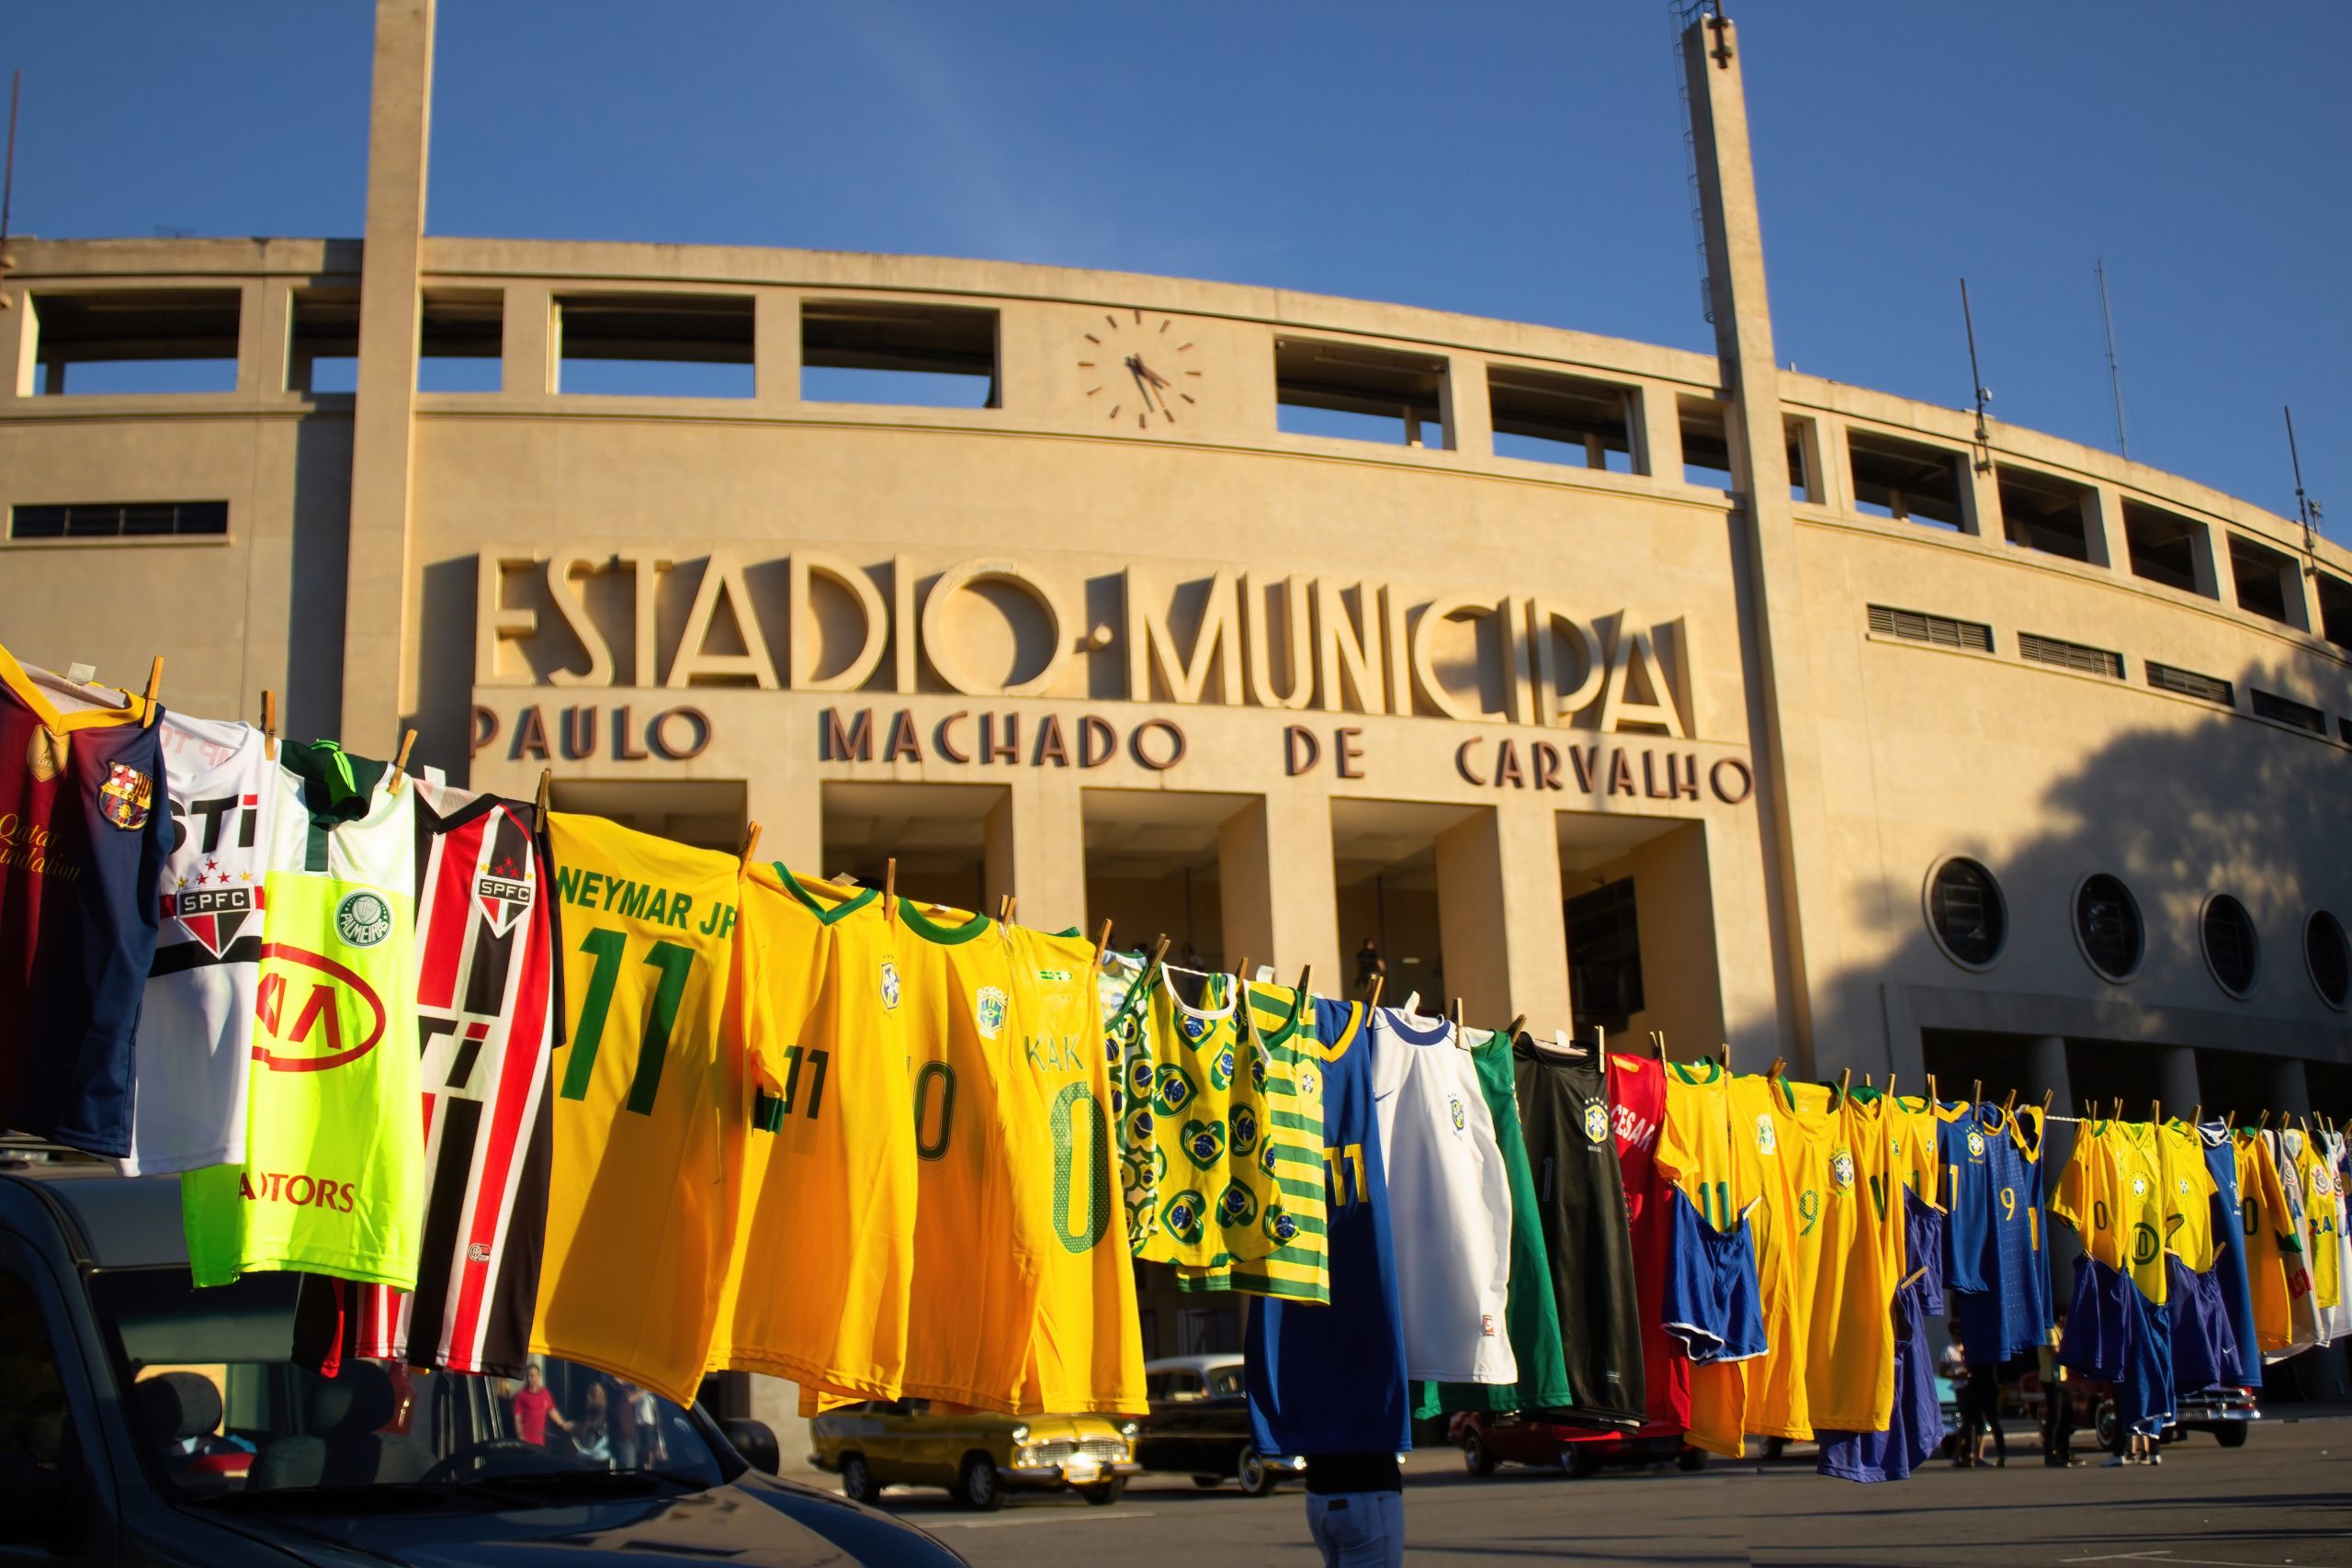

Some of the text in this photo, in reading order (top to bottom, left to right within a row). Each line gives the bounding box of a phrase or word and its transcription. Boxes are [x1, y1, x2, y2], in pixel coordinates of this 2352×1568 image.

[474, 548, 1074, 698] ESTADIO
[470, 705, 1755, 804] PAULO MACHADO DE CARVALHO
[184, 891, 245, 911] SPFC
[481, 882, 530, 900] SPFC
[558, 865, 693, 930] NEYMAR
[340, 913, 390, 943] PALMEIRAS
[560, 927, 695, 1117] 11
[783, 1044, 830, 1120] 11
[906, 1055, 957, 1162] 0
[1799, 1190, 1819, 1235] 9
[1999, 1187, 2016, 1221] 9
